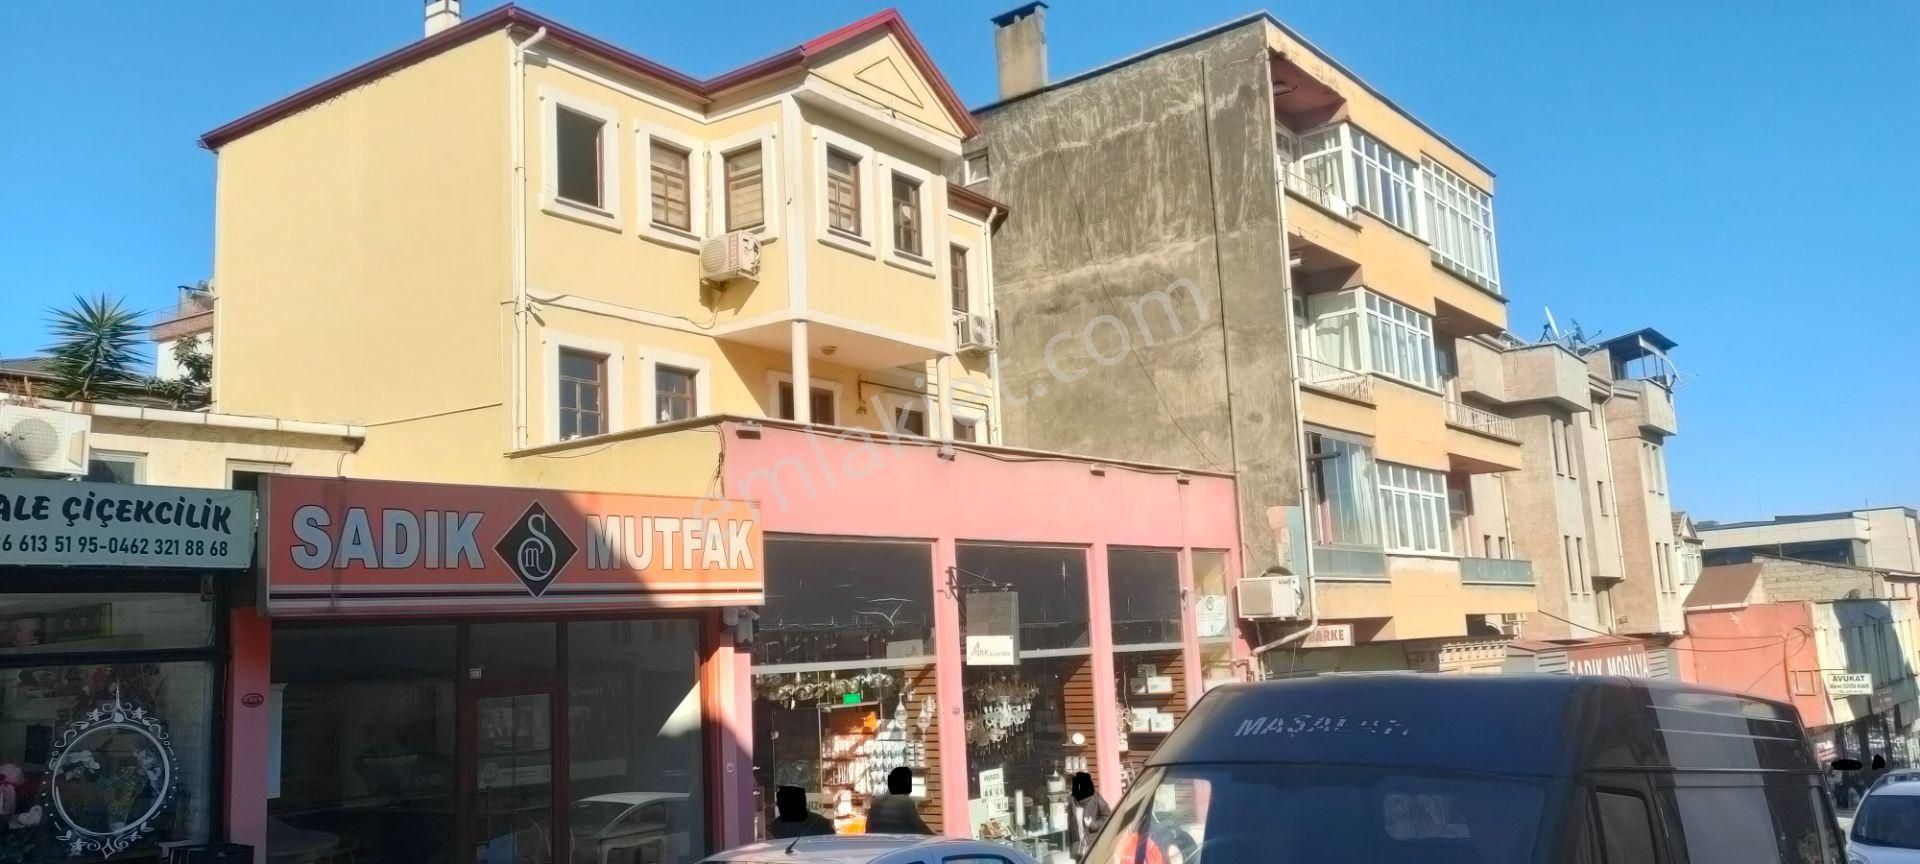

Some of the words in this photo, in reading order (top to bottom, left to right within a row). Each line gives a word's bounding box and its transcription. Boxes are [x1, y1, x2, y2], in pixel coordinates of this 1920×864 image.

[62, 490, 232, 535] ÇİÇEKCİLİK
[19, 535, 48, 552] 613
[55, 535, 71, 553] 51
[78, 536, 149, 555] 95-0462
[154, 539, 179, 556] 321
[185, 540, 204, 556] 88
[210, 541, 228, 557] 68
[291, 504, 486, 570] SADIK
[586, 514, 755, 571] MUTFAK
[1233, 713, 1410, 738] MAŞAL
